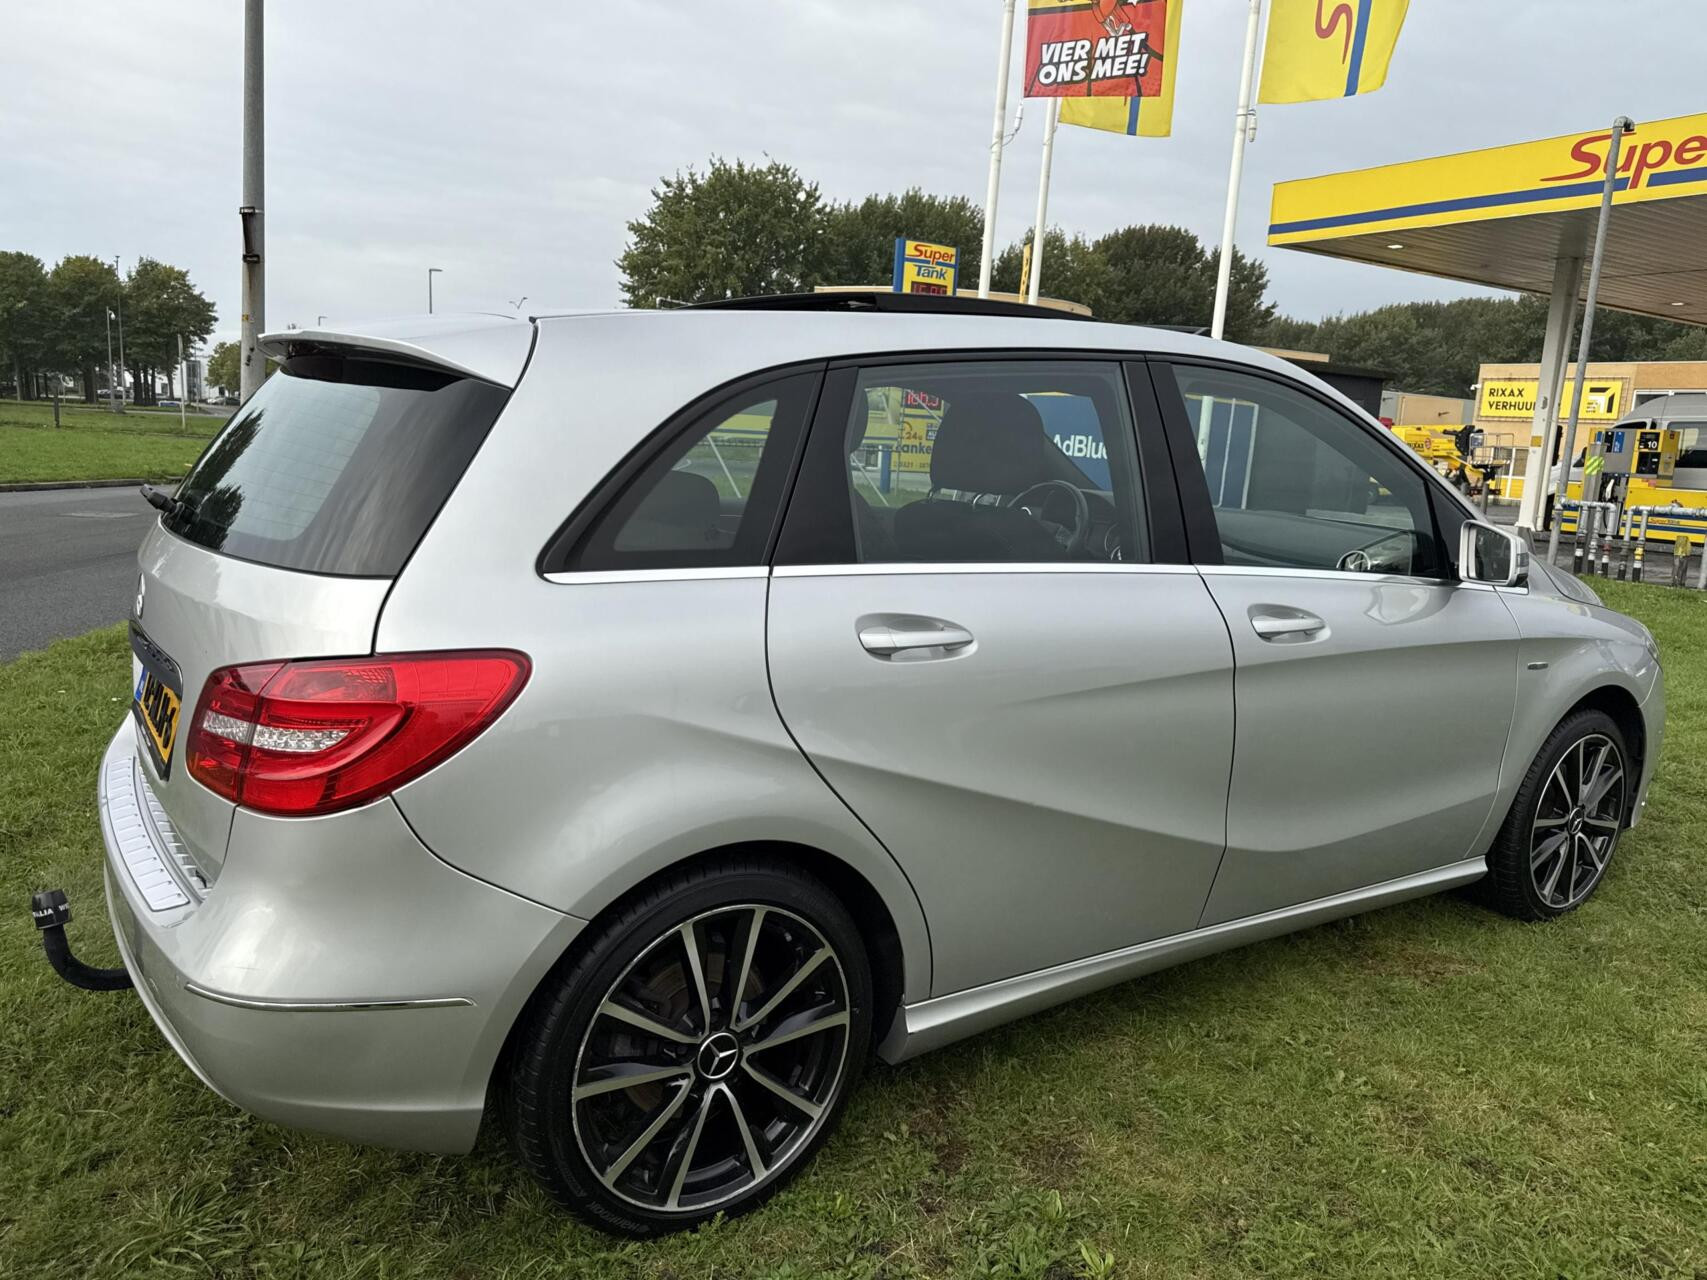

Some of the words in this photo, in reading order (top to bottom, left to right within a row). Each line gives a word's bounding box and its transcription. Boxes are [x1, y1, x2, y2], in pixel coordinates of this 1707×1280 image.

[1041, 40, 1091, 63] VIER
[1095, 32, 1146, 58] MET
[1039, 60, 1088, 84] ONS
[1090, 53, 1149, 80] MEE!
[906, 243, 955, 265] Super
[912, 264, 948, 280] Tank
[1488, 387, 1525, 398] RIXAX
[1487, 400, 1537, 412] VERHUU
[1647, 440, 1658, 449] 10
